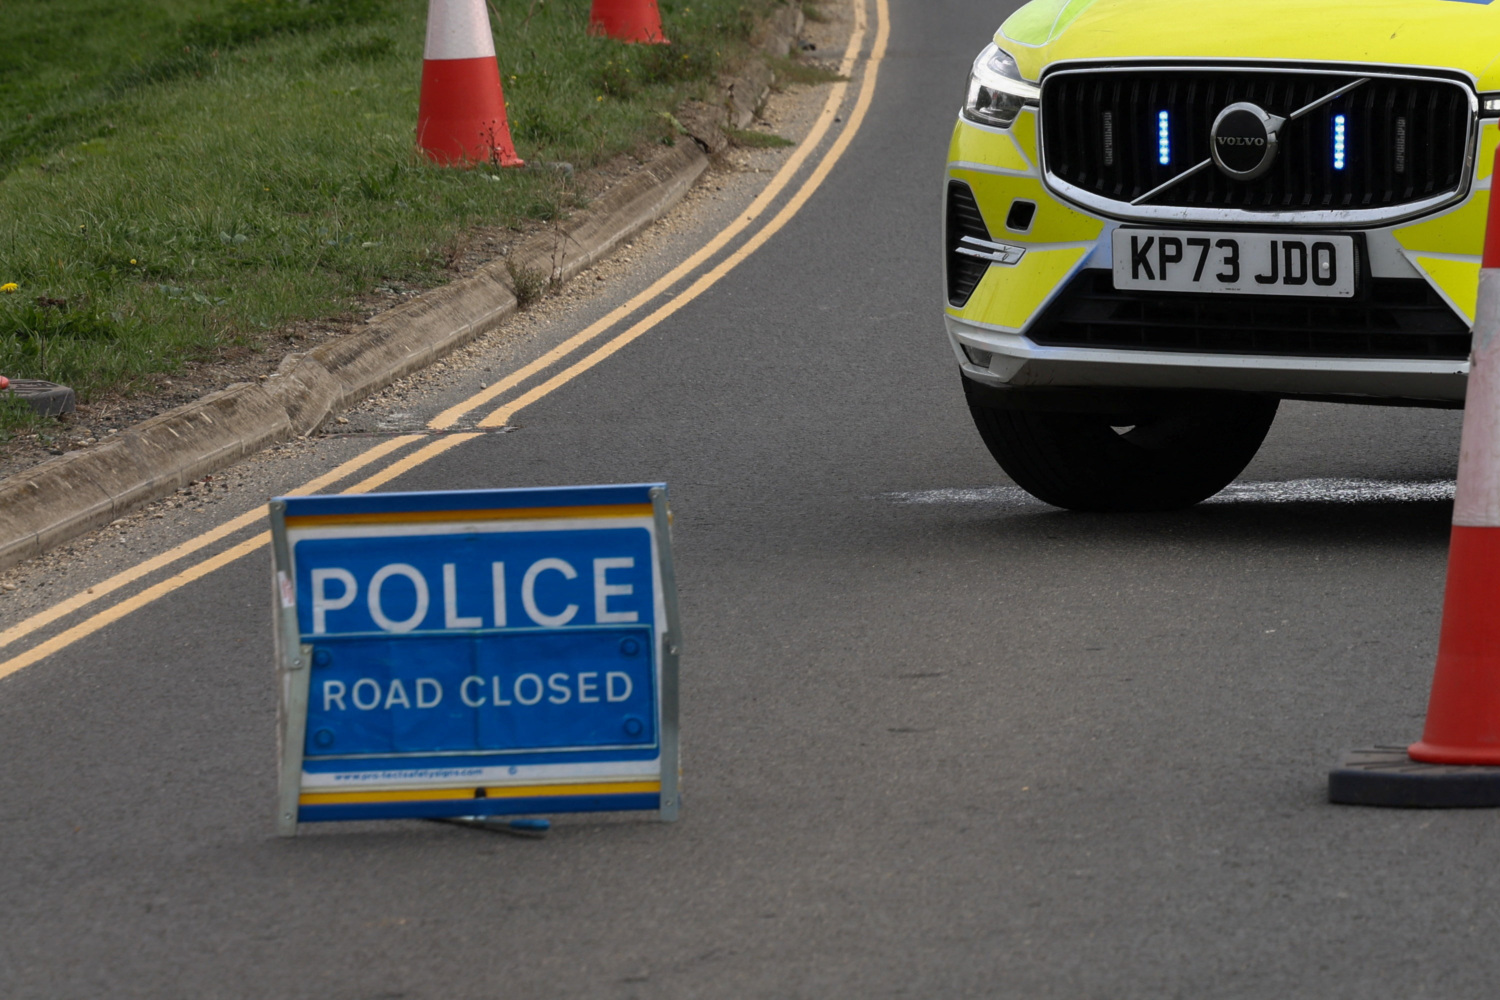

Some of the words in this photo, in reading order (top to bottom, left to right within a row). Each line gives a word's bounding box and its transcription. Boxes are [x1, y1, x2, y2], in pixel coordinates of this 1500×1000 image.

[1216, 136, 1265, 146] VOLVO
[1130, 235, 1240, 283] KP73
[1254, 240, 1337, 286] JDO
[310, 557, 639, 635] POLICE
[322, 677, 443, 712] ROAD
[459, 671, 633, 708] CLOSED
